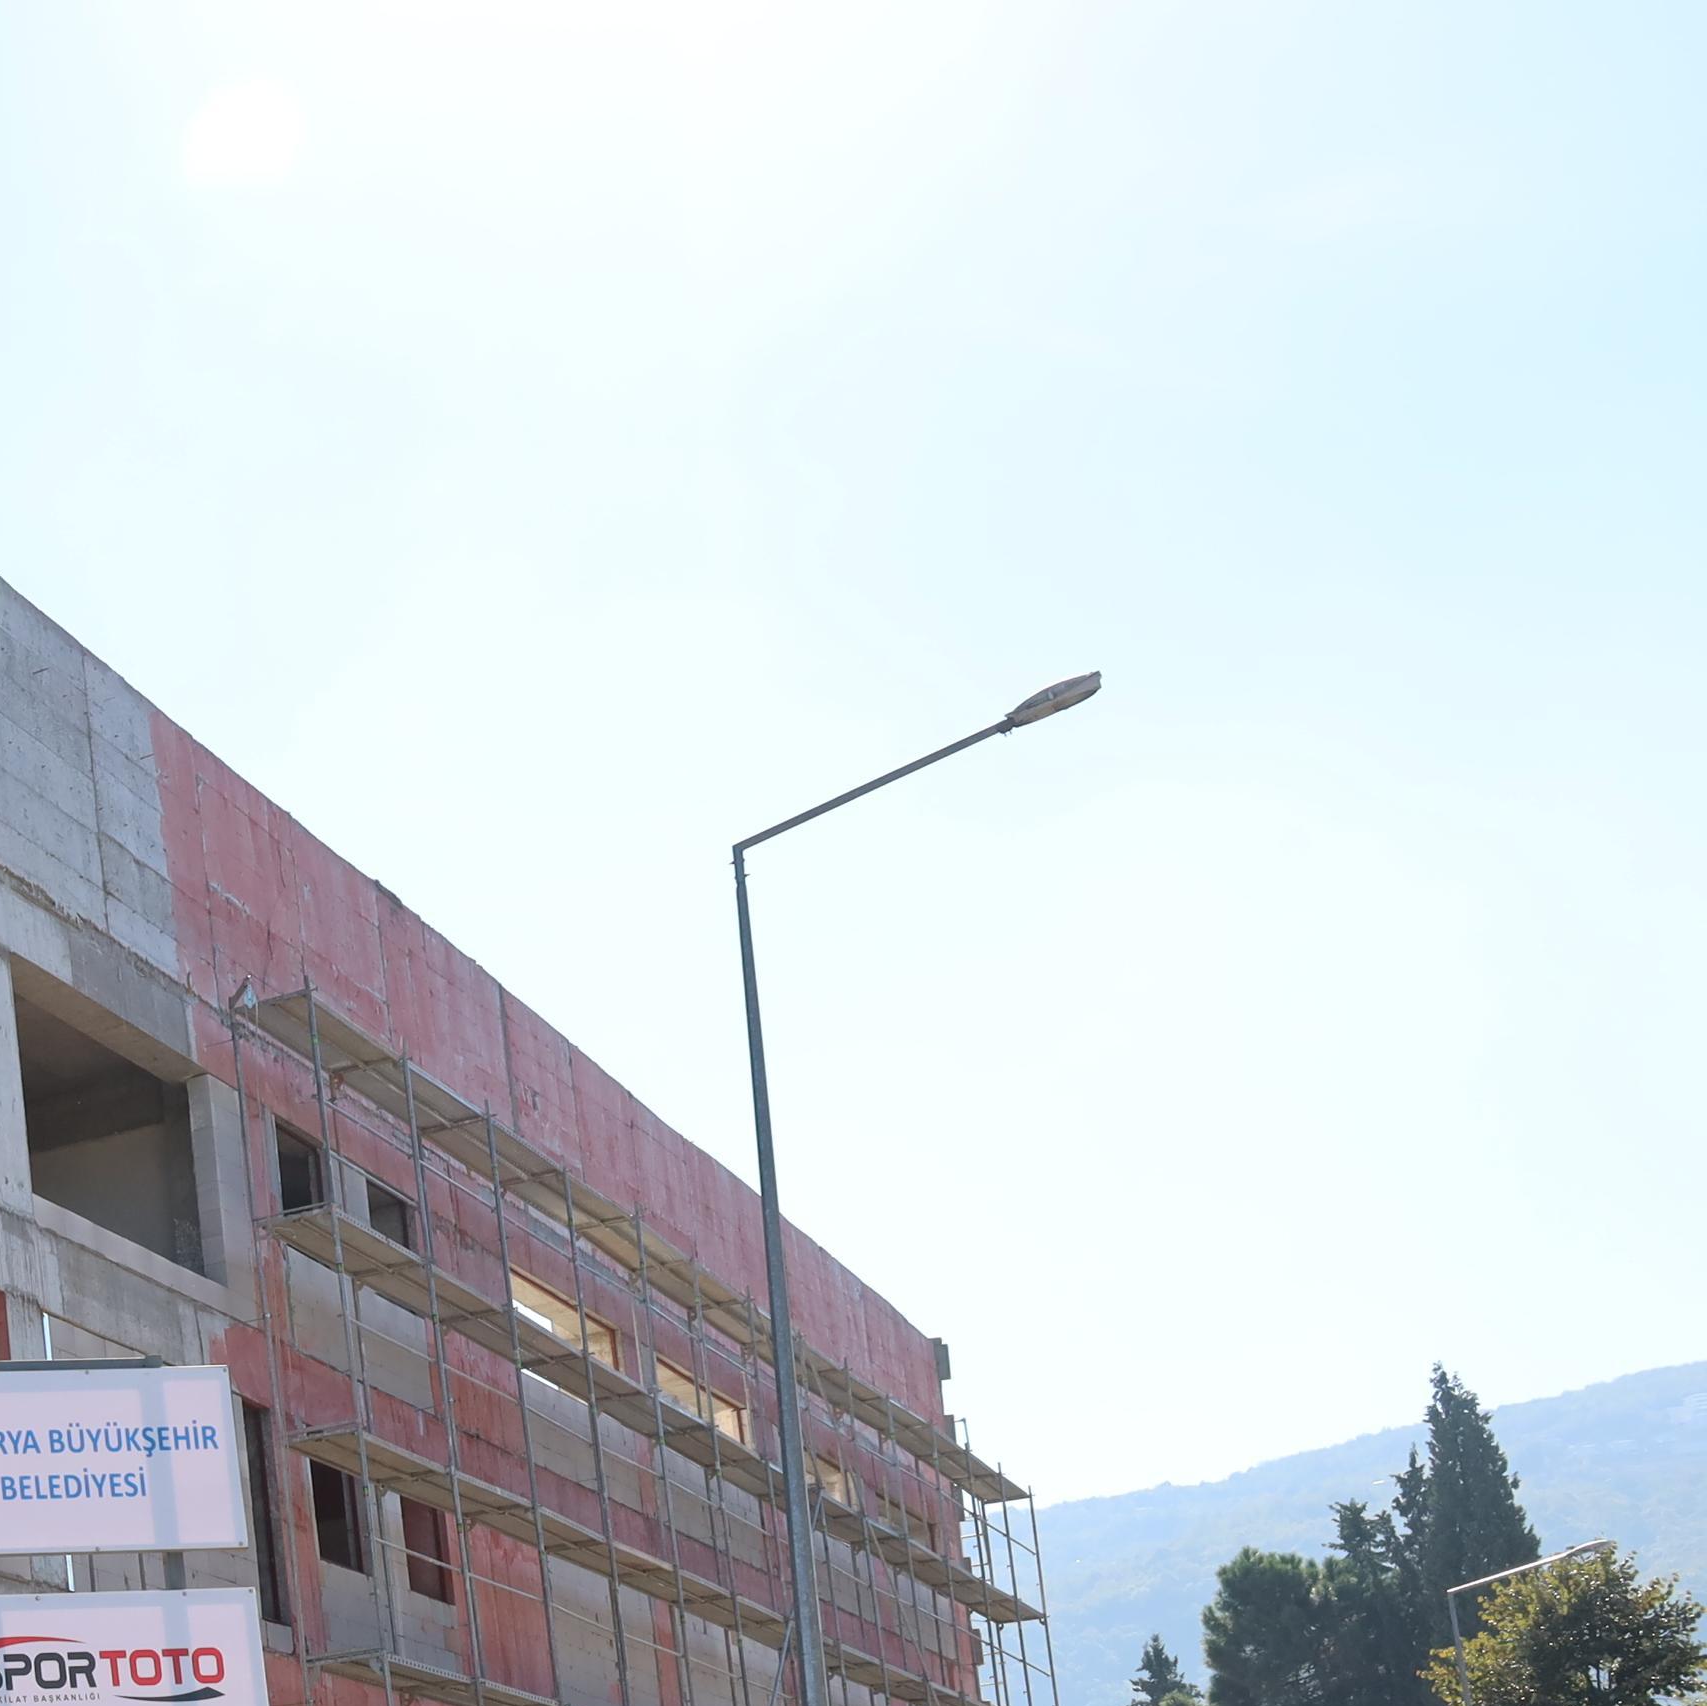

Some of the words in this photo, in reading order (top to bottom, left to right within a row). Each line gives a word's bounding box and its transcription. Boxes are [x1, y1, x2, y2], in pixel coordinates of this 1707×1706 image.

[48, 1418, 219, 1459] BÜYÜKŞEHİR
[0, 1469, 148, 1502] BELEDİYESİ
[33, 1692, 101, 1704] BAŞKANLIĞI
